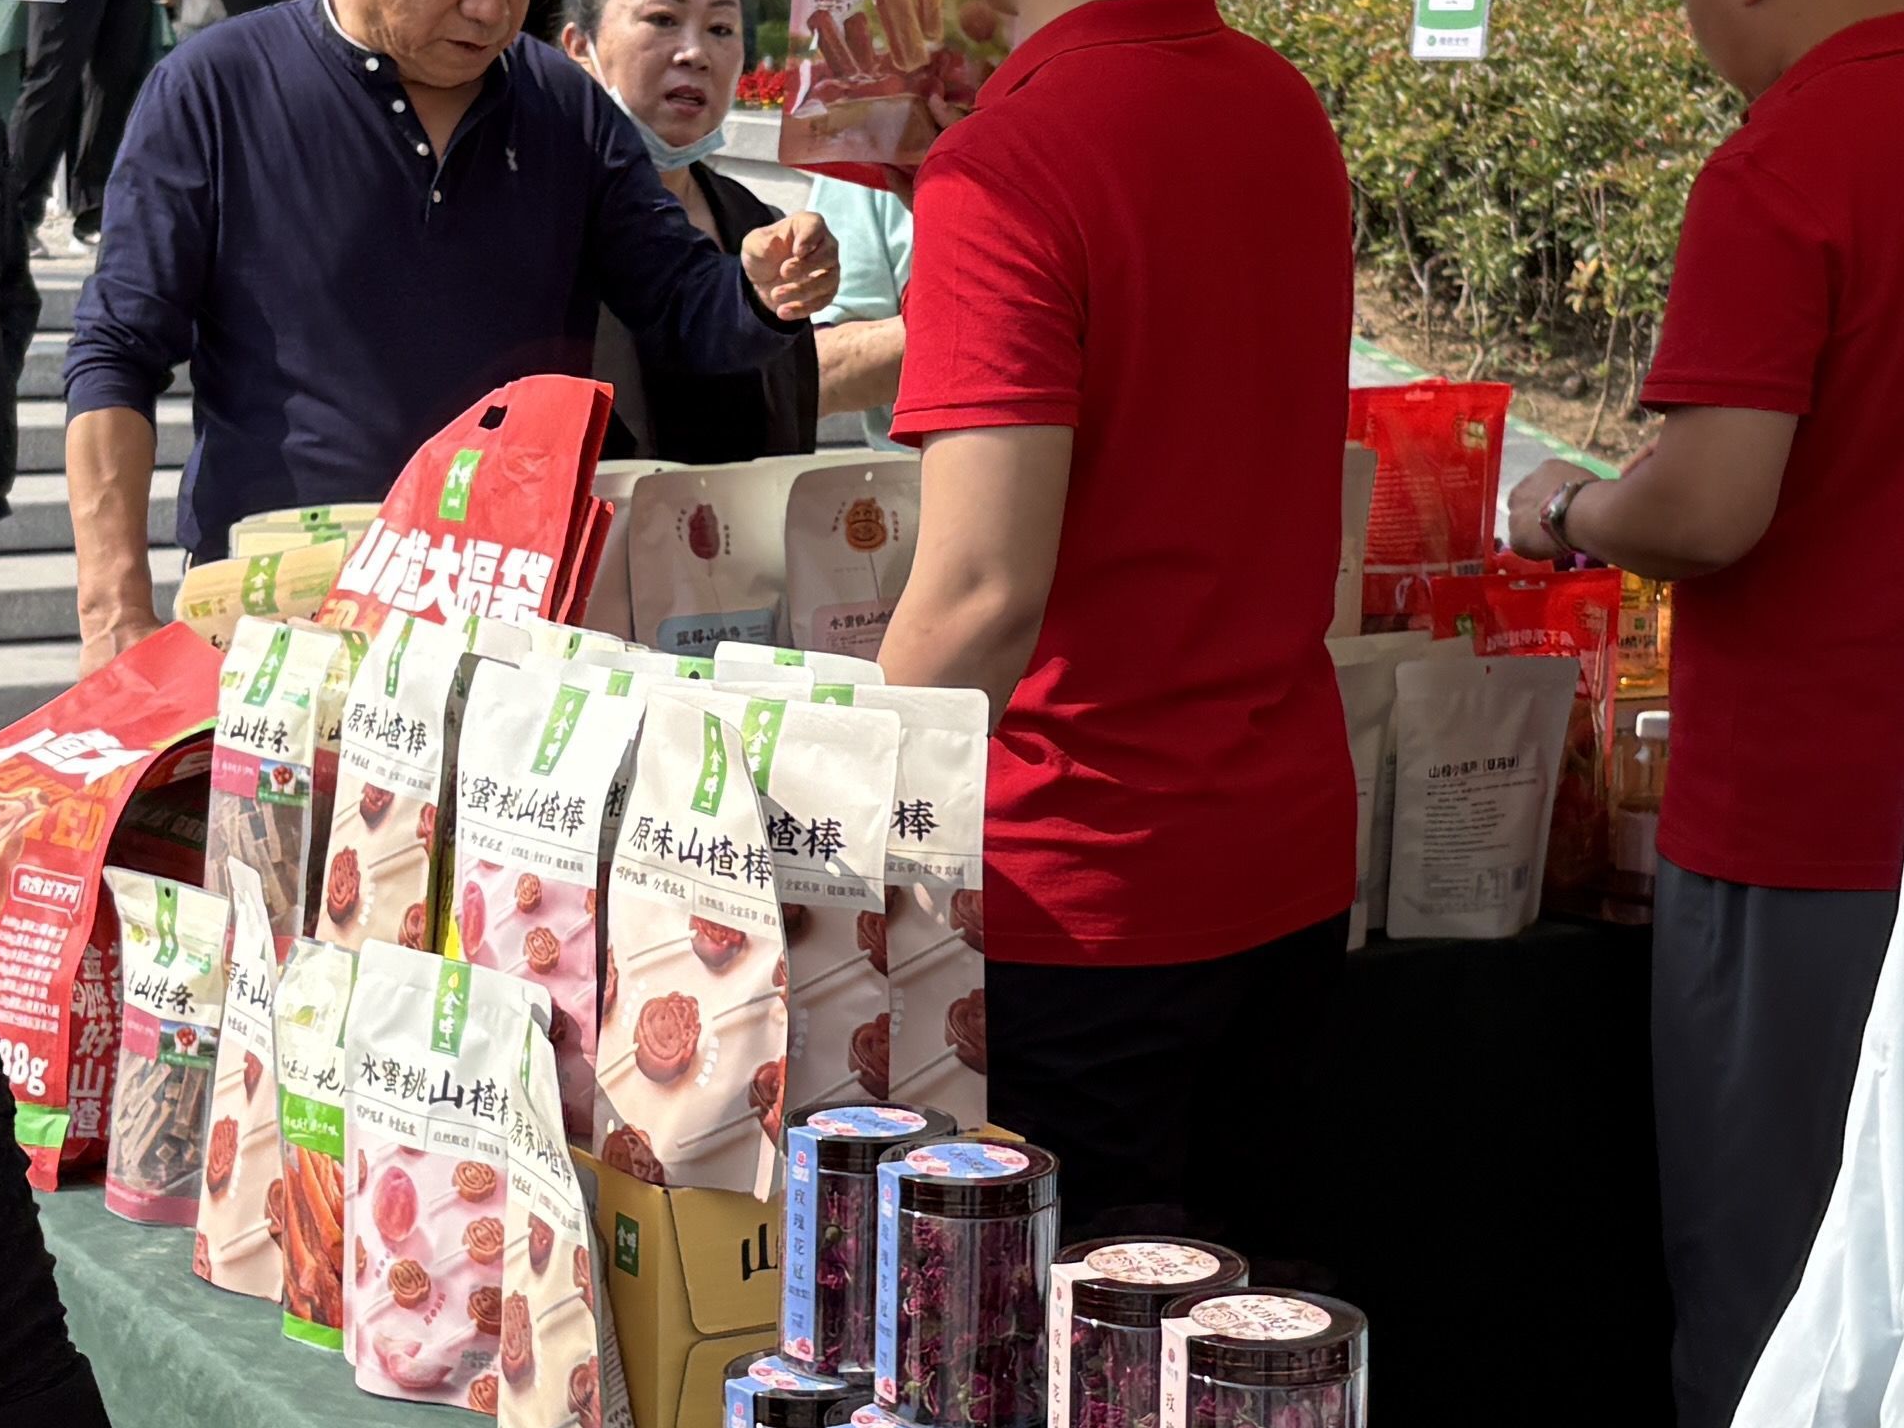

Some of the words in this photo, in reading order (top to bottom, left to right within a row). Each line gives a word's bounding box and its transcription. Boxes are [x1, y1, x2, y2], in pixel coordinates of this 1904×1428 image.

[890, 798, 941, 842] 棒
[628, 816, 774, 890] 原味山楂棒
